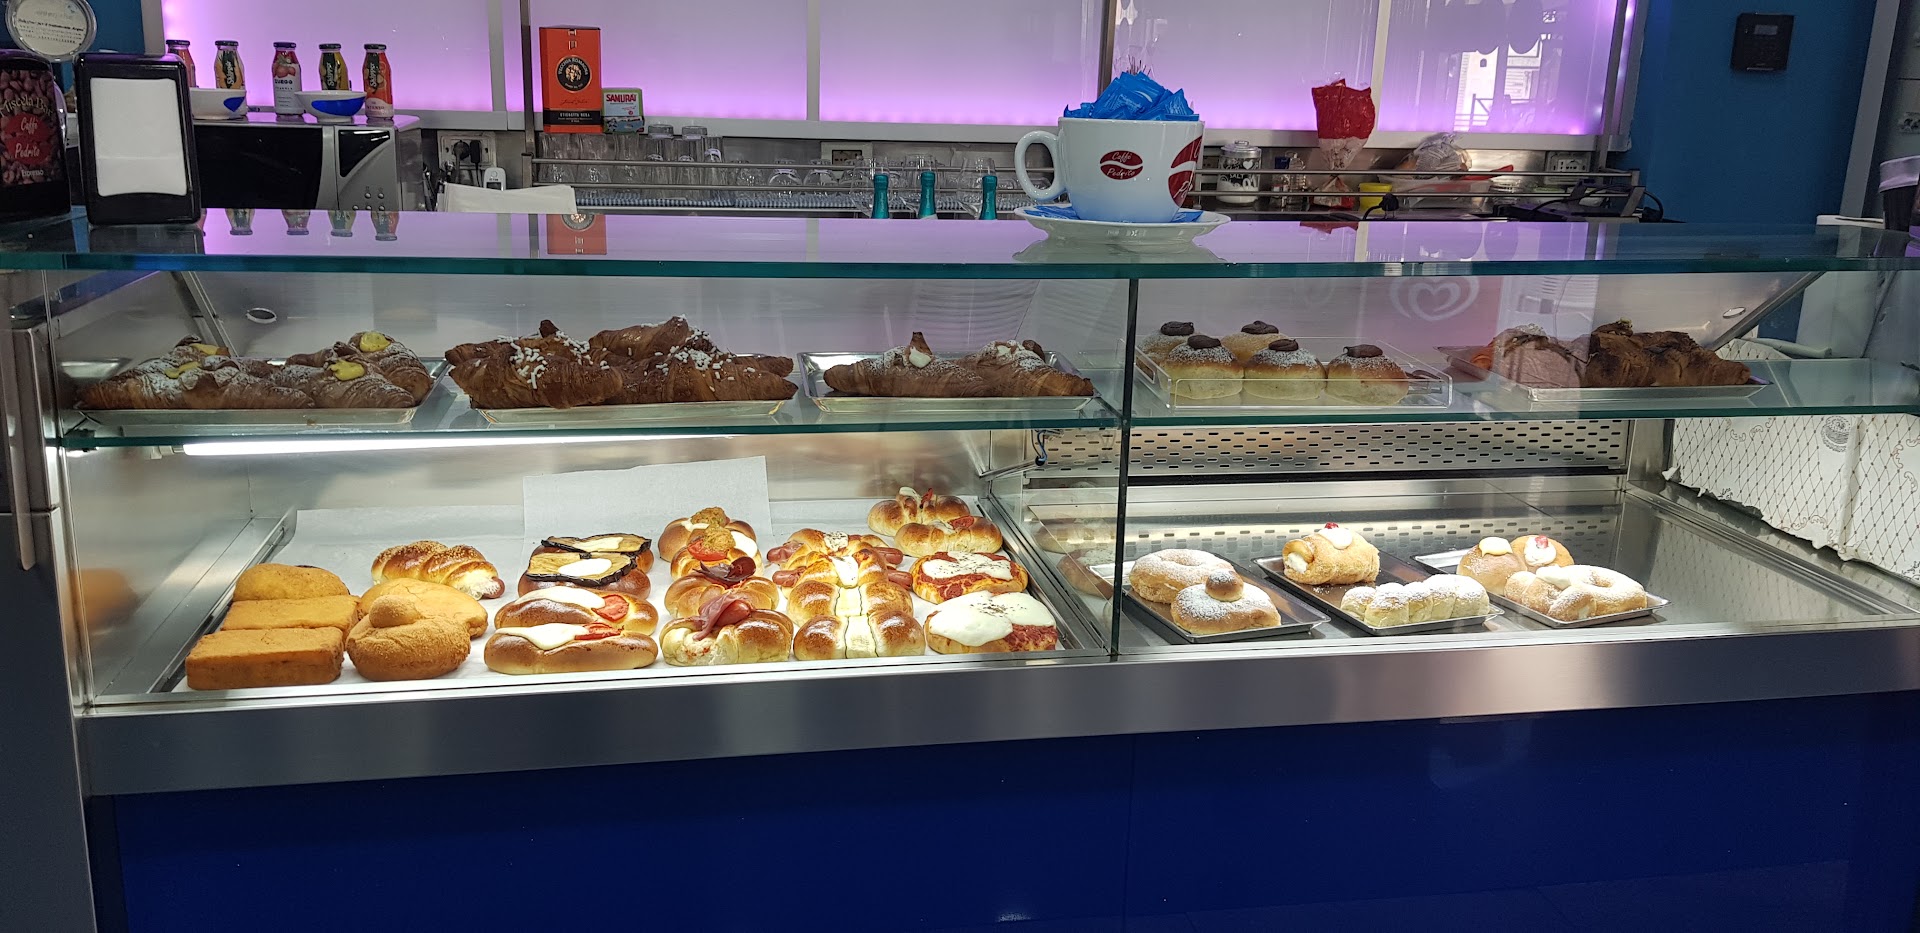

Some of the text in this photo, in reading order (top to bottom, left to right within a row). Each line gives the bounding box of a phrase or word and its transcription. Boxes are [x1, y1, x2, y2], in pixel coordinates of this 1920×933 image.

[326, 62, 335, 87] Skipper
[369, 62, 378, 88] Skipper
[606, 93, 637, 102] SAMURAI
[15, 143, 40, 158] Pedrito
